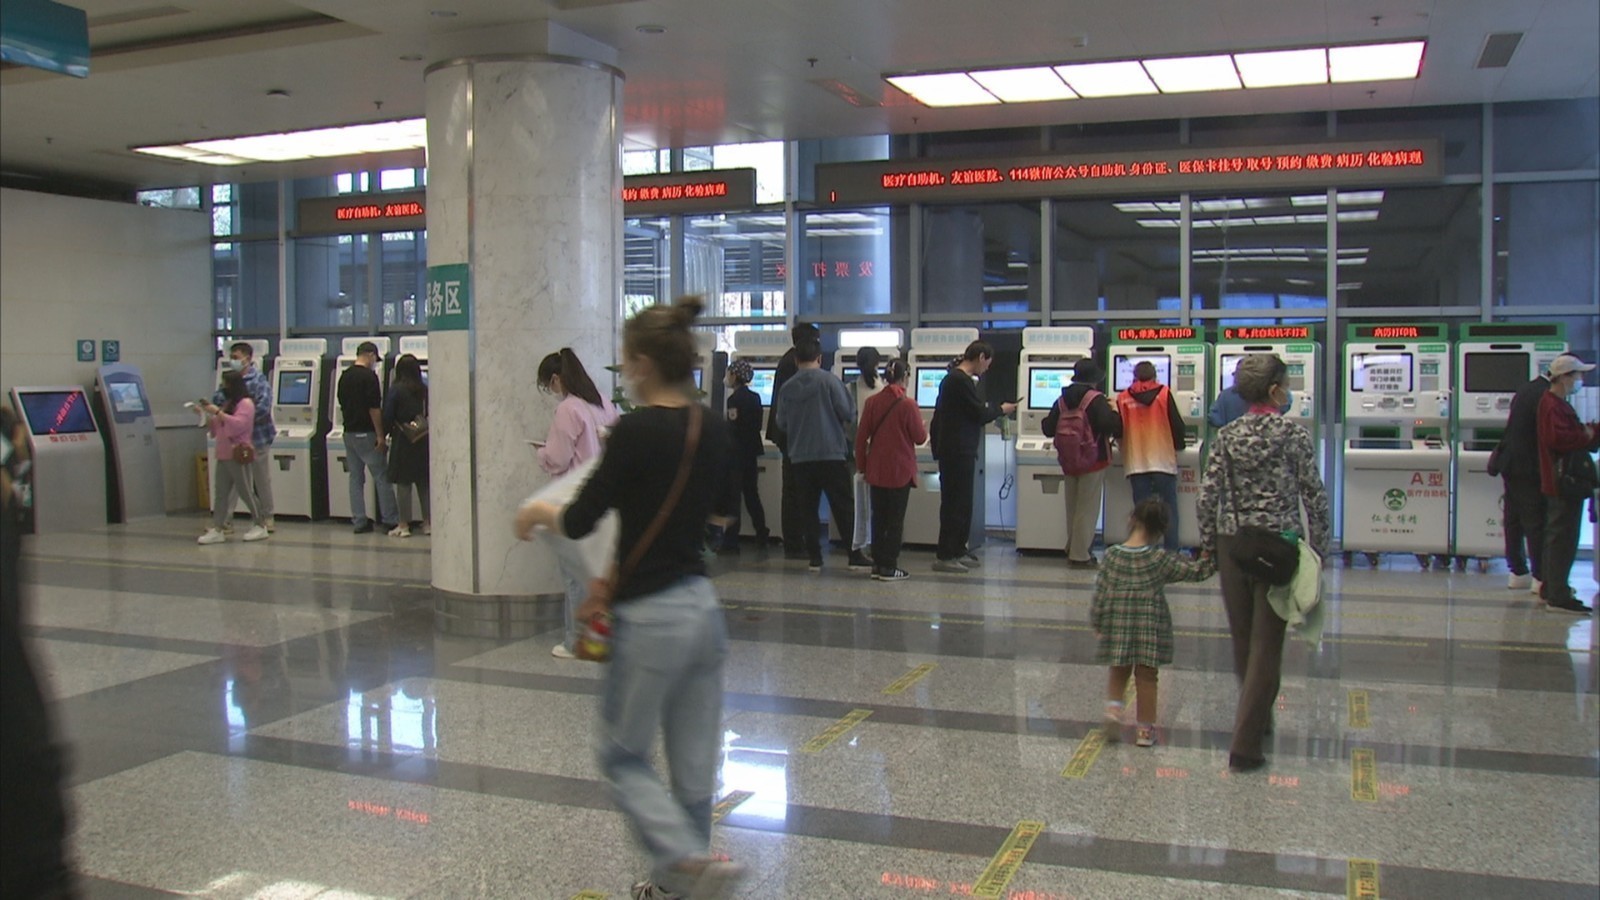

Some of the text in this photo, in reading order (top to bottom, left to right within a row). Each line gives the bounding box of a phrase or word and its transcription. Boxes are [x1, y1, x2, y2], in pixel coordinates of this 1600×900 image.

[1246, 155, 1273, 172] 取号
[1276, 154, 1302, 171] 预约
[1306, 153, 1333, 169] 缴费
[1336, 152, 1363, 168] 病历
[1367, 150, 1423, 166] 化验病理
[427, 280, 462, 317] 务区
